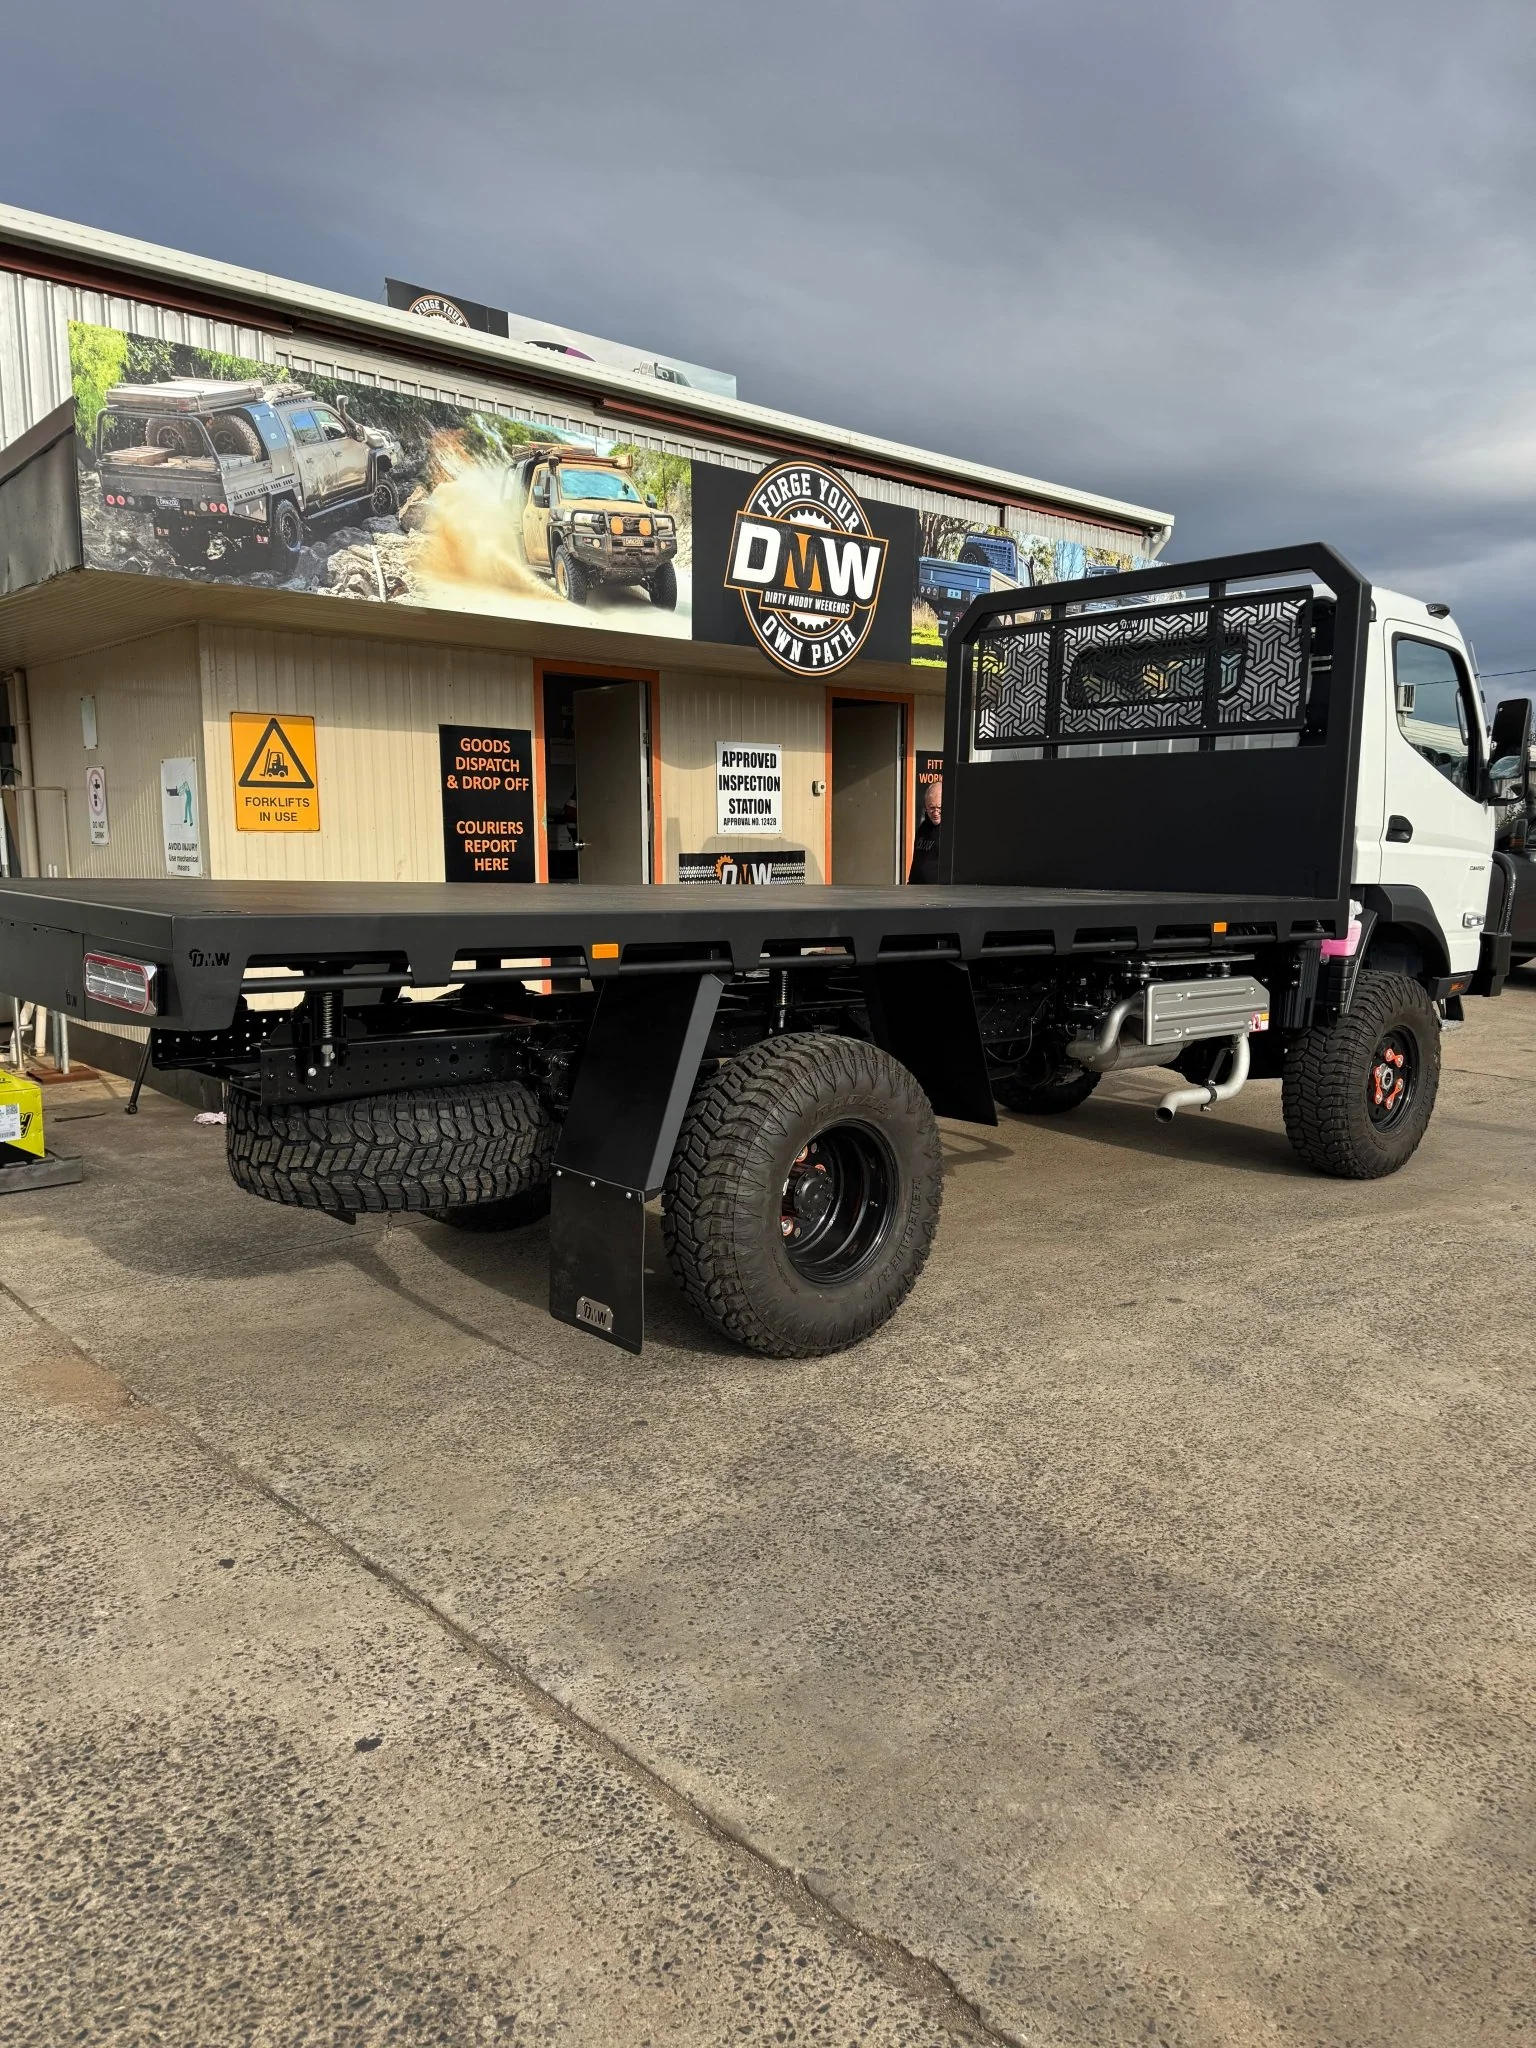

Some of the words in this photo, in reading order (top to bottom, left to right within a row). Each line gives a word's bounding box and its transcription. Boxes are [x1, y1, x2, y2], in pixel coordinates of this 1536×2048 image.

[415, 299, 440, 315] FORGE
[442, 302, 464, 326] YOUR
[757, 472, 811, 517] FORGE
[820, 476, 860, 533] YOUR
[732, 521, 881, 600] DMW
[765, 591, 787, 605] DIRTY
[788, 594, 813, 609] MUDDY
[815, 596, 851, 614] WEEKENDS
[762, 615, 803, 663] OWN
[812, 625, 856, 666] PATH
[460, 737, 511, 753] GOODS
[455, 756, 520, 773] DISPATCH
[722, 751, 777, 768] APPROVED
[447, 774, 458, 789] &
[462, 775, 501, 791] DROP
[504, 777, 529, 791] OFF
[718, 774, 781, 792] INSPECTION
[245, 796, 310, 808] FORKLIFTS
[728, 798, 771, 814] STATION
[259, 811, 271, 822] IN
[274, 812, 298, 822] USE
[723, 817, 751, 826] APPROVAL
[751, 817, 761, 826] NO.
[456, 820, 524, 835] COURIERS
[168, 843, 181, 851] AVOID
[181, 843, 198, 851] INJURY
[464, 839, 517, 853] REPORT
[168, 854, 176, 862] Use
[176, 854, 199, 863] mechanical
[474, 857, 509, 871] HERE
[177, 864, 190, 872] means
[721, 863, 773, 885] DMW
[190, 951, 231, 967] DMW
